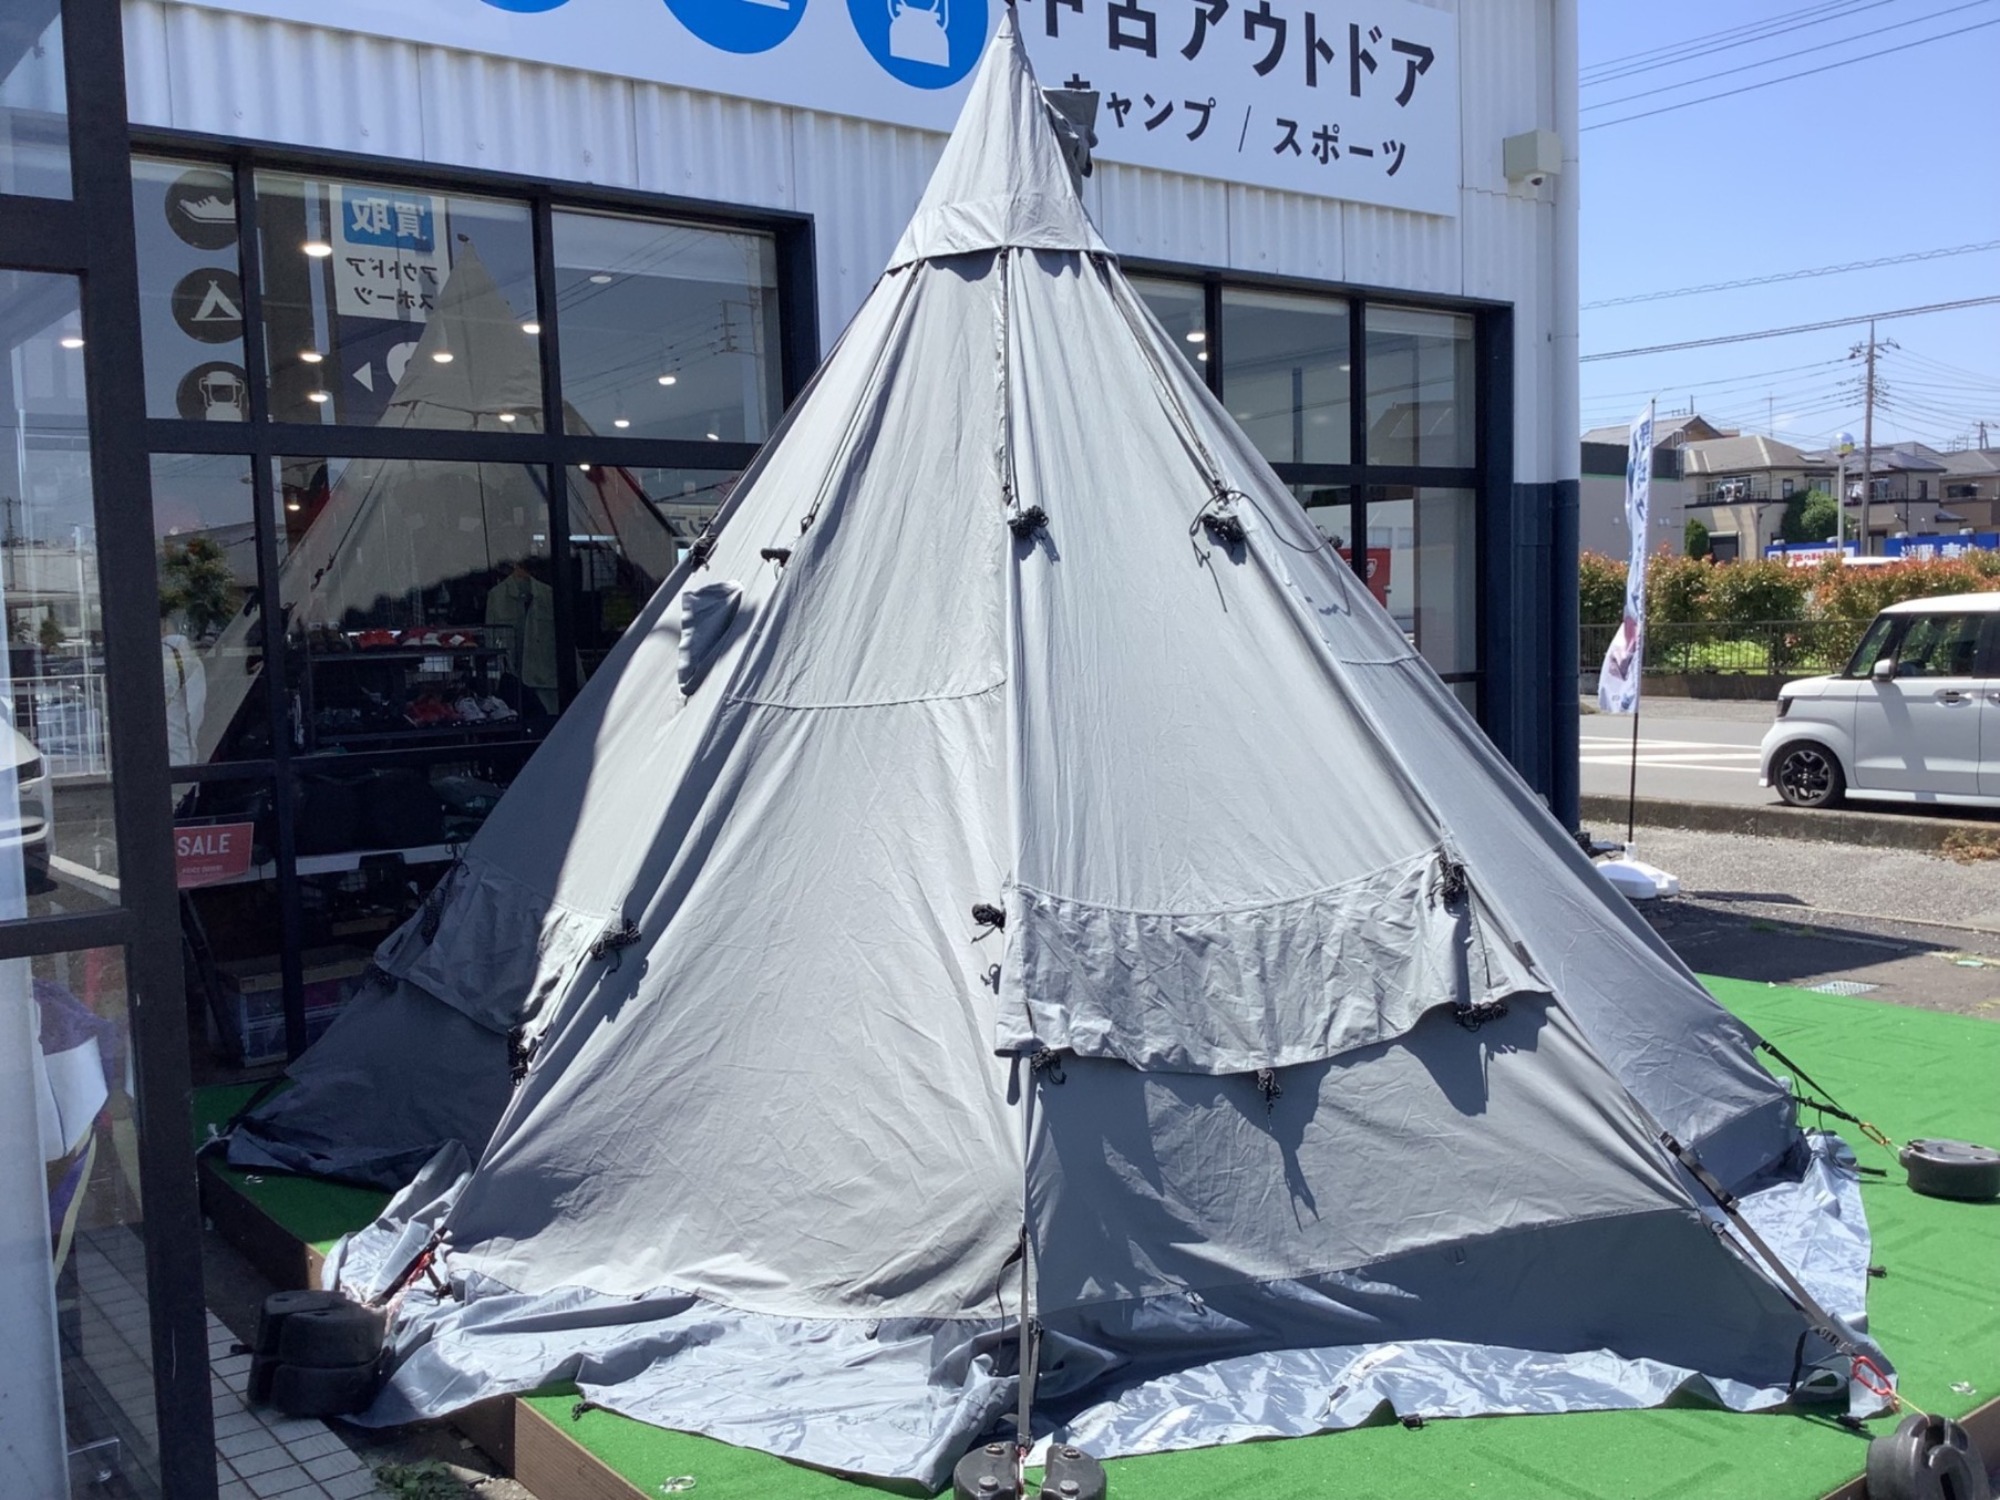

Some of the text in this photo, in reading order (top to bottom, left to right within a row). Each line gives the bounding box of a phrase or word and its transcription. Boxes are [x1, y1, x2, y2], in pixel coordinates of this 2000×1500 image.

[1273, 117, 1406, 177] スポーツ
[177, 833, 231, 856] SALE
